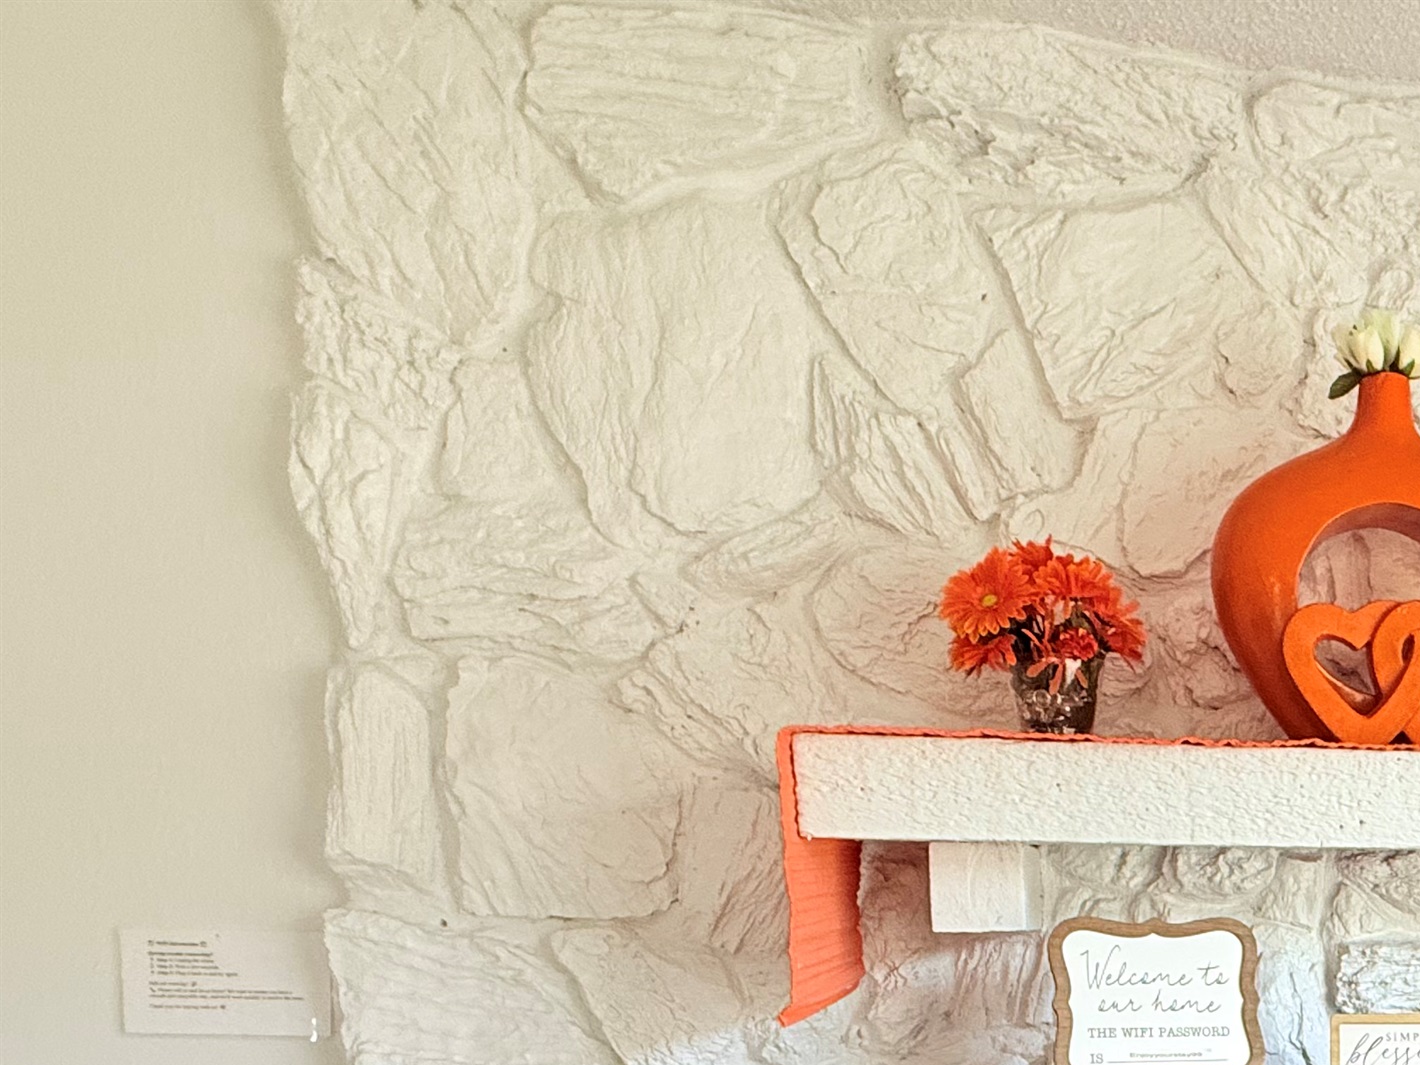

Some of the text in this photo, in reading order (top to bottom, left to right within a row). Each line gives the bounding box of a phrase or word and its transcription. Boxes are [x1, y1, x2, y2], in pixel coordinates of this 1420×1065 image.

[1080, 944, 1230, 990] Welcome to
[1098, 989, 1221, 1013] our home
[1087, 1026, 1230, 1039] THE WIFI PASSWORD
[1090, 1053, 1104, 1065] IS
